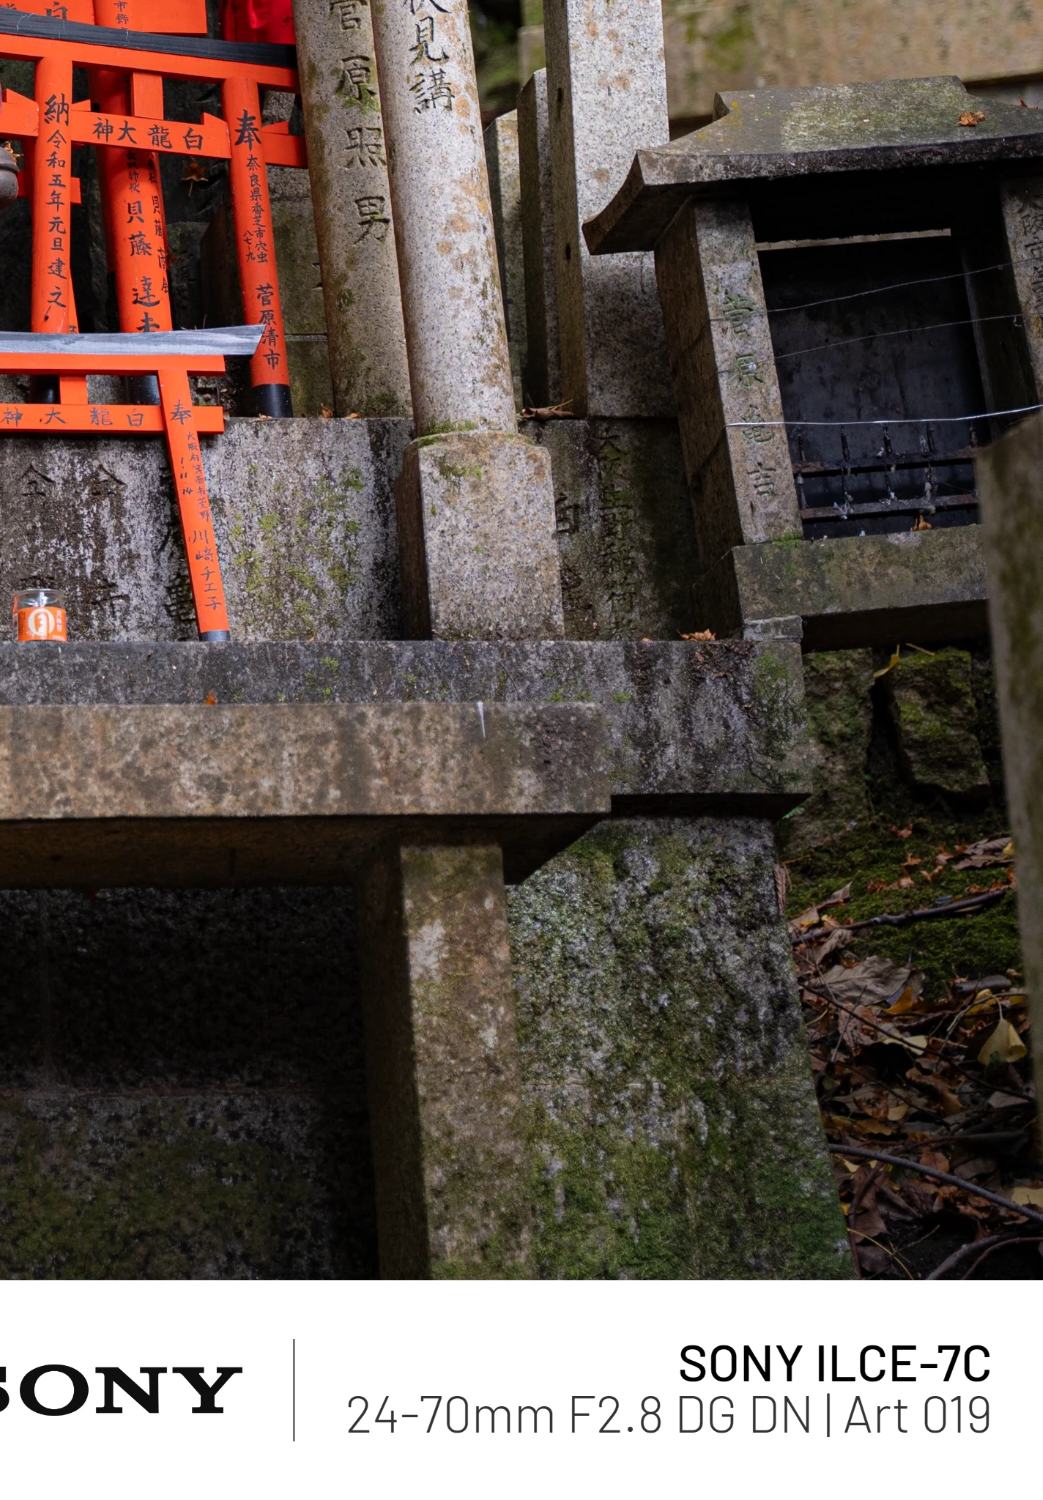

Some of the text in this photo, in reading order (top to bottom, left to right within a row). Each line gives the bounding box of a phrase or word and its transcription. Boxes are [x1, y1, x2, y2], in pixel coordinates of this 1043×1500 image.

[44, 92, 70, 127] 納
[235, 109, 262, 151] 奉
[170, 400, 193, 426] 奉
